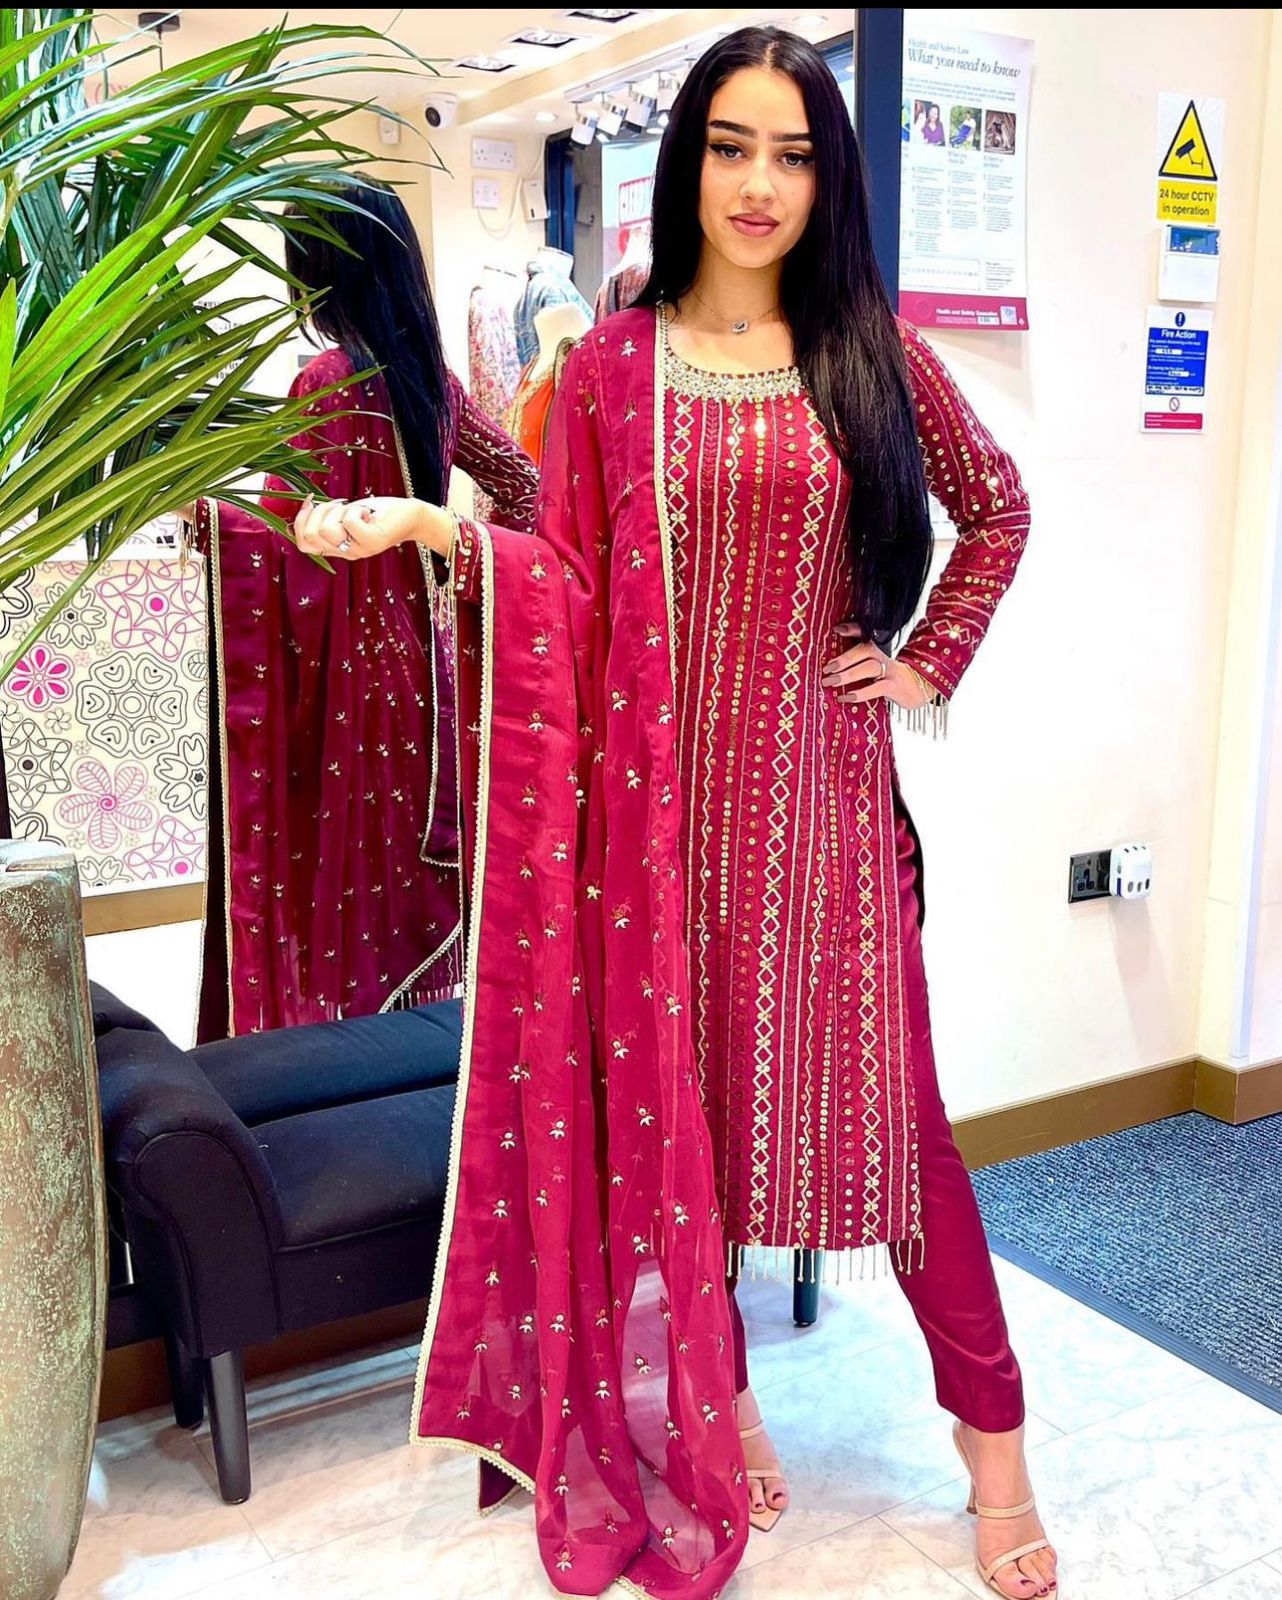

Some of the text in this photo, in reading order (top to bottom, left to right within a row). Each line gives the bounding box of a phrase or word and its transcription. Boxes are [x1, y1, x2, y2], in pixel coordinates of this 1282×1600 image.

[929, 42, 939, 50] and
[957, 46, 970, 55] Law
[908, 48, 1021, 78] What you need to know
[1160, 188, 1214, 202] 24 hour CCTV
[1162, 203, 1210, 215] in operation
[1161, 329, 1197, 339] Fire Action
